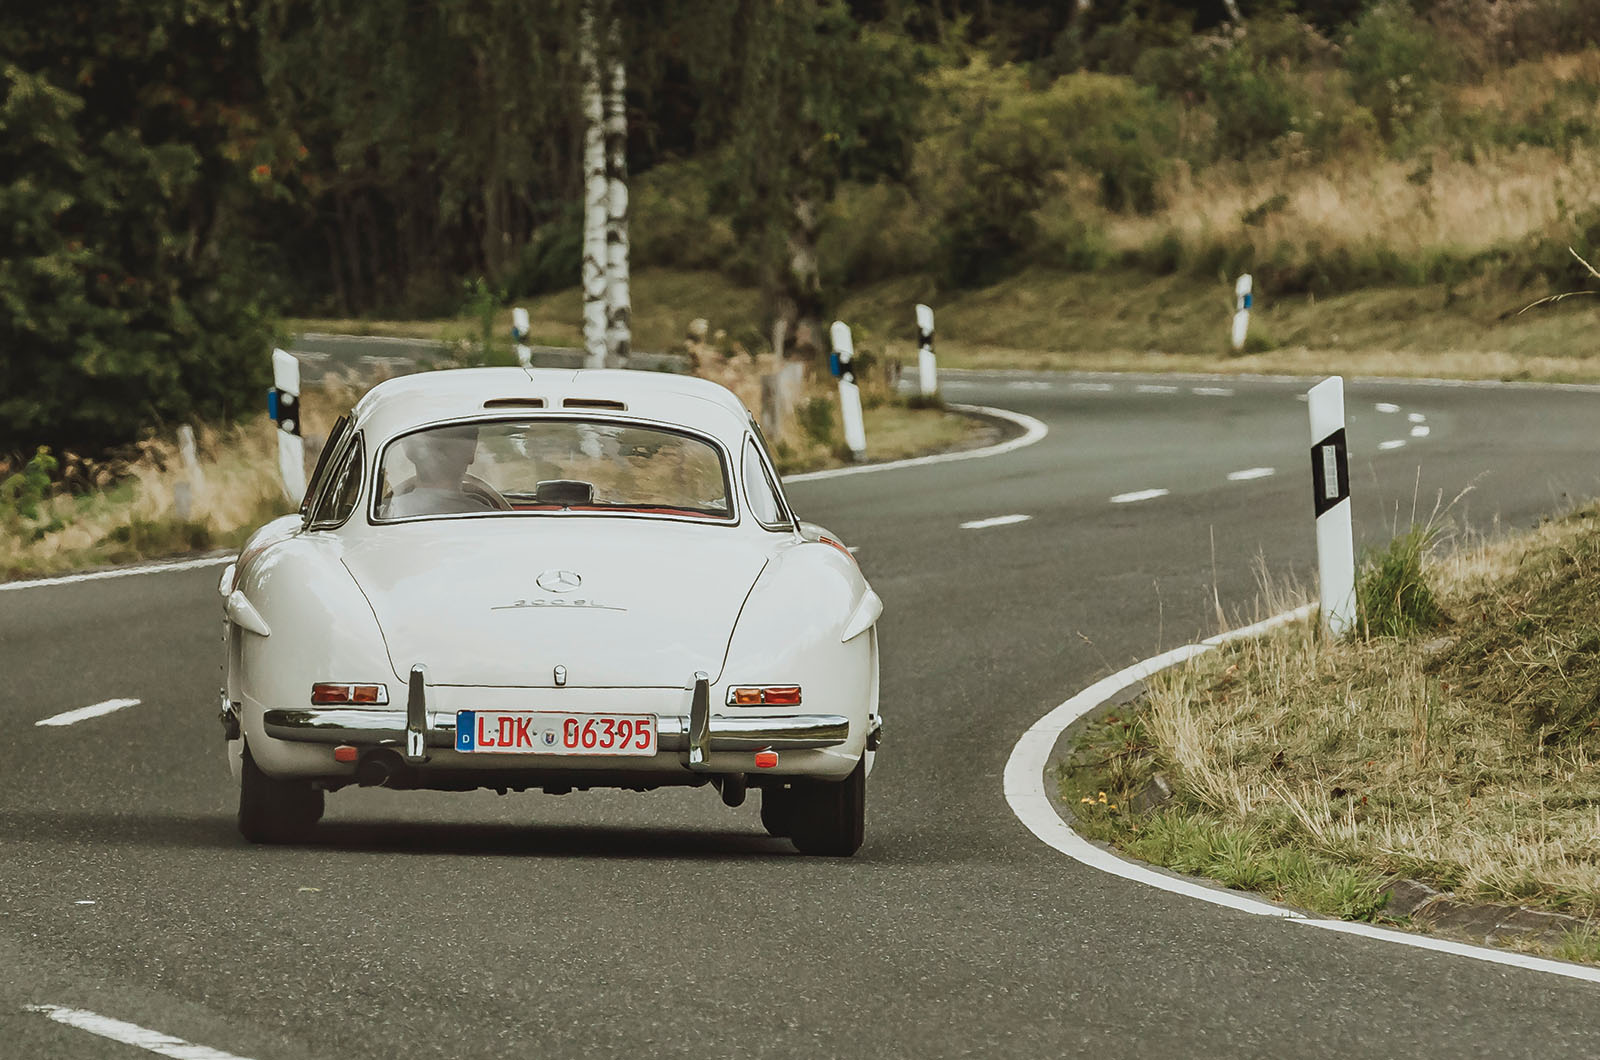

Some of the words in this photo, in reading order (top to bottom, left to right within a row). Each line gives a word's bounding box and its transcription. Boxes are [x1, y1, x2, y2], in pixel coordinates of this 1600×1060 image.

[462, 734, 470, 744] D
[477, 716, 534, 748] LDK
[563, 718, 651, 750] 06395
